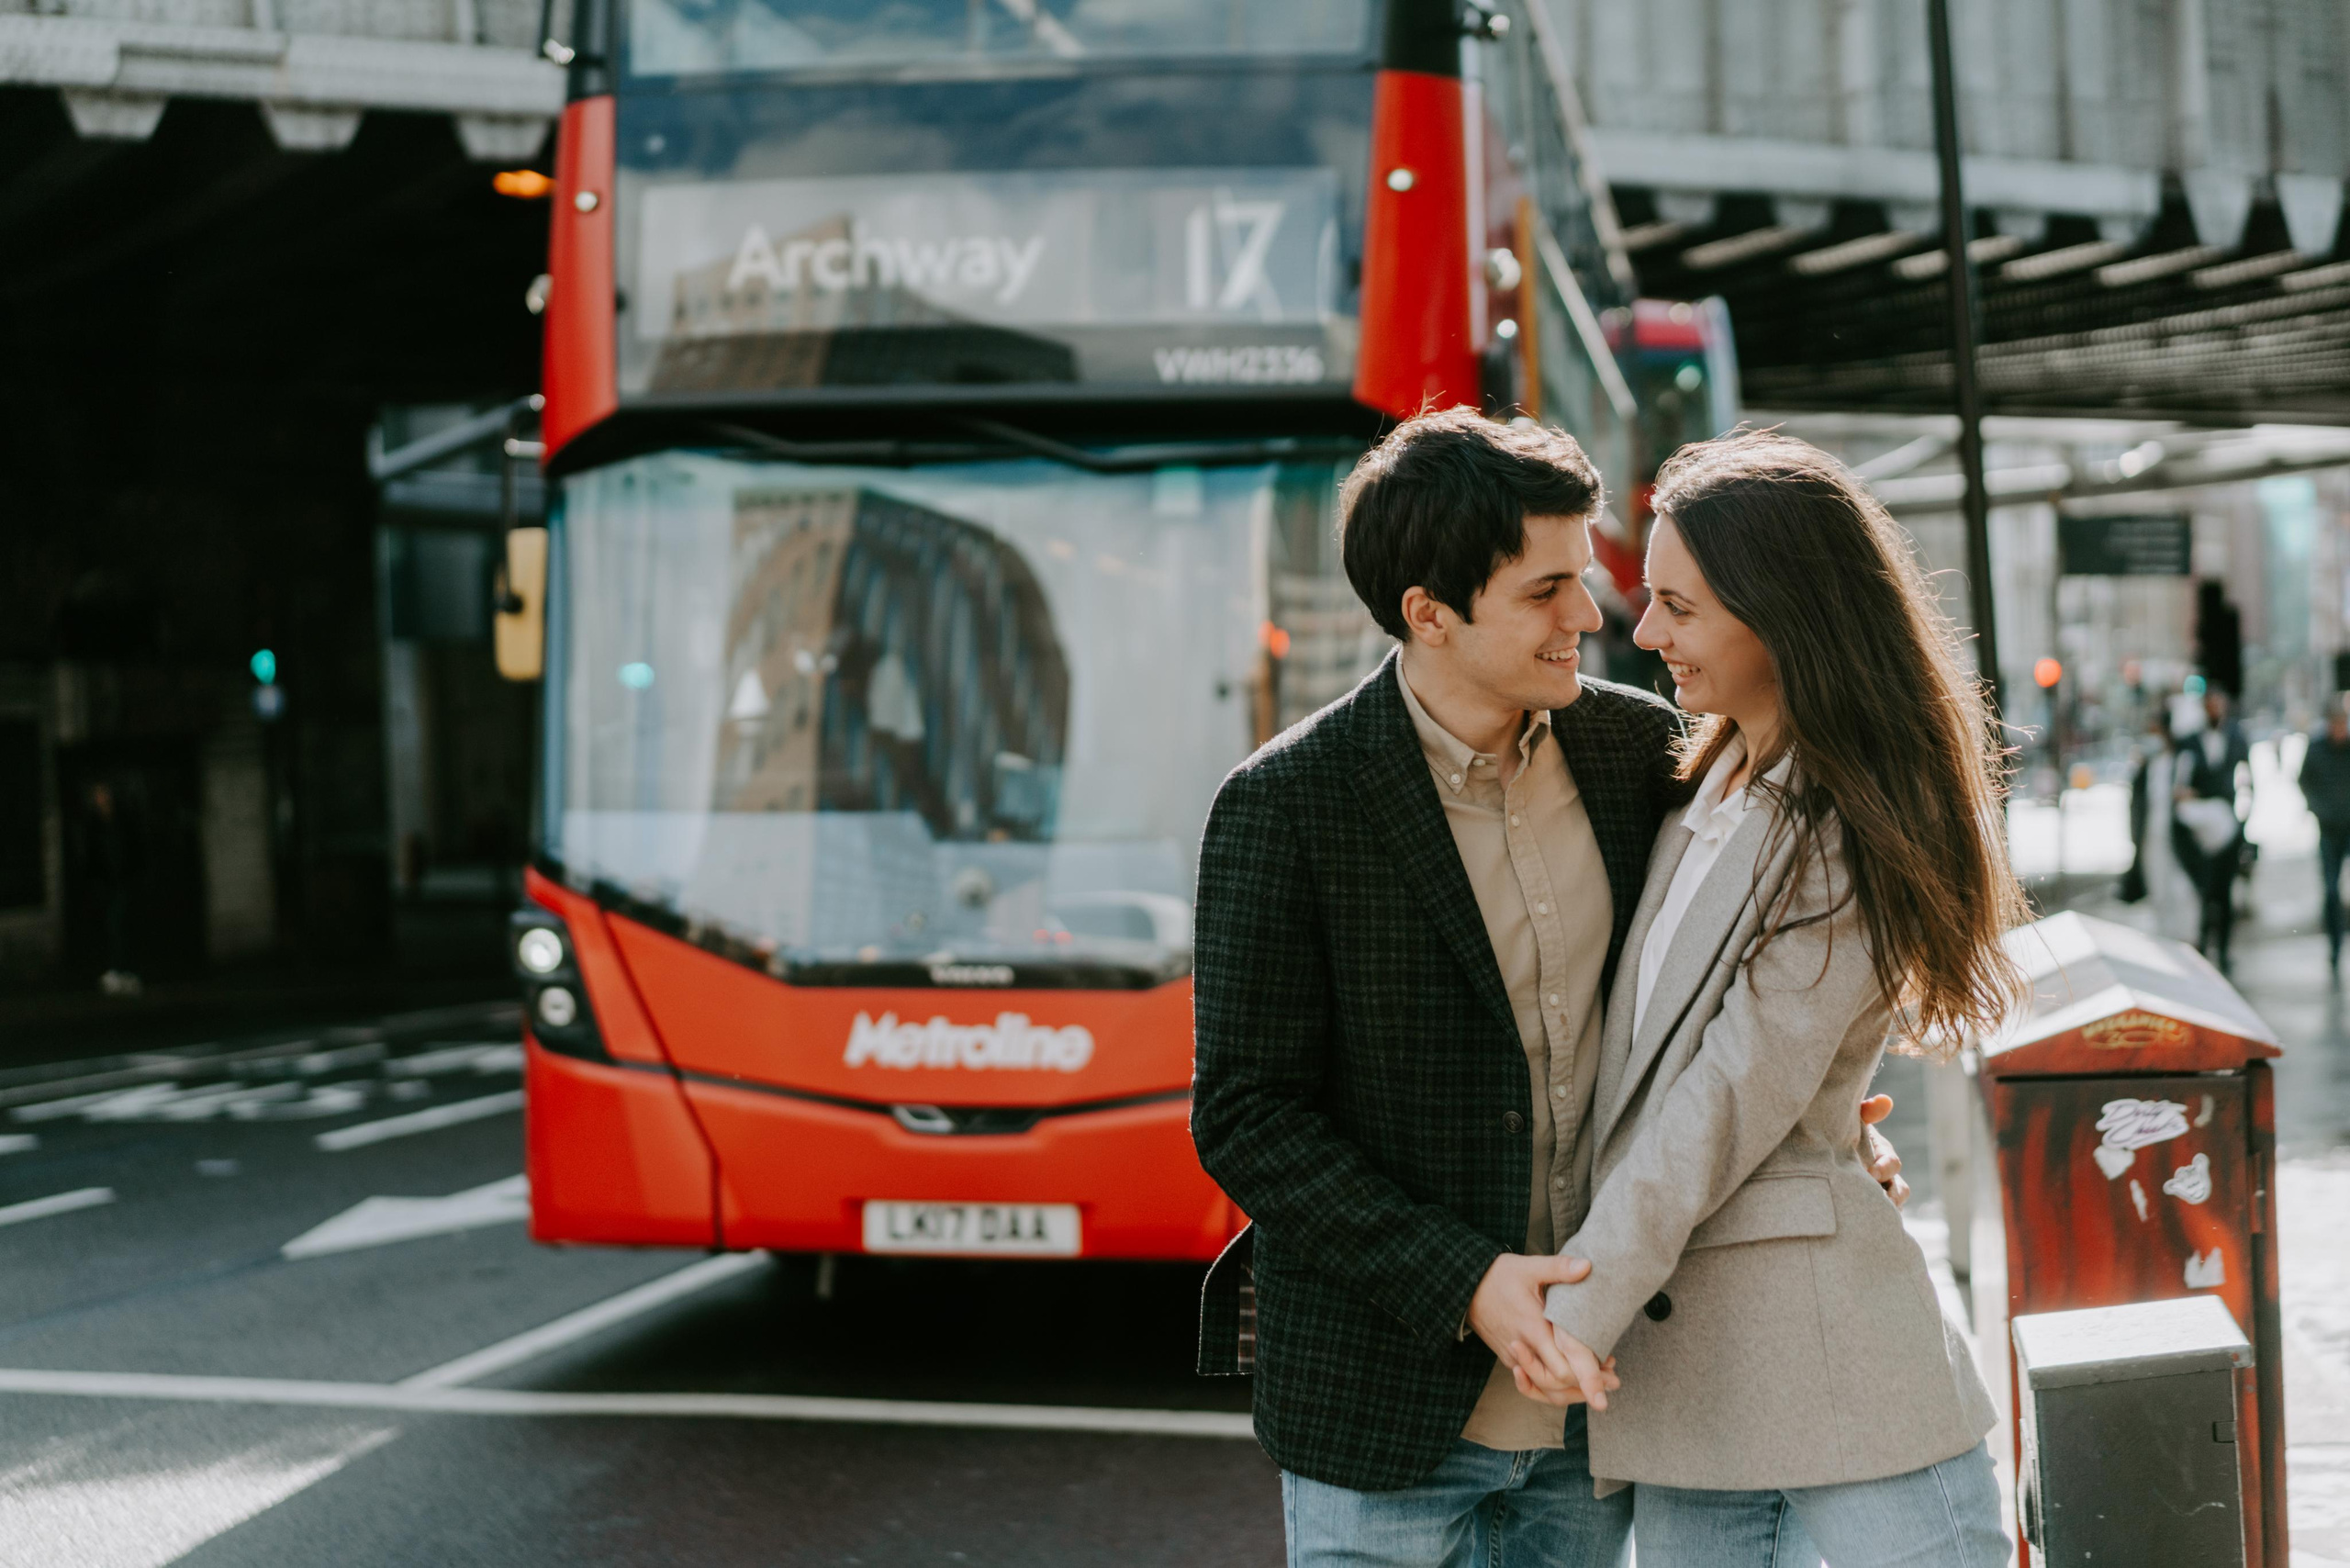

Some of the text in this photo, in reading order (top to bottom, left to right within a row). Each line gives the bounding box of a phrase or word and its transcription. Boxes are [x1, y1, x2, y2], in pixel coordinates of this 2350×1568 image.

[727, 200, 1283, 308] Archway 17
[844, 1011, 1094, 1072] Metroline
